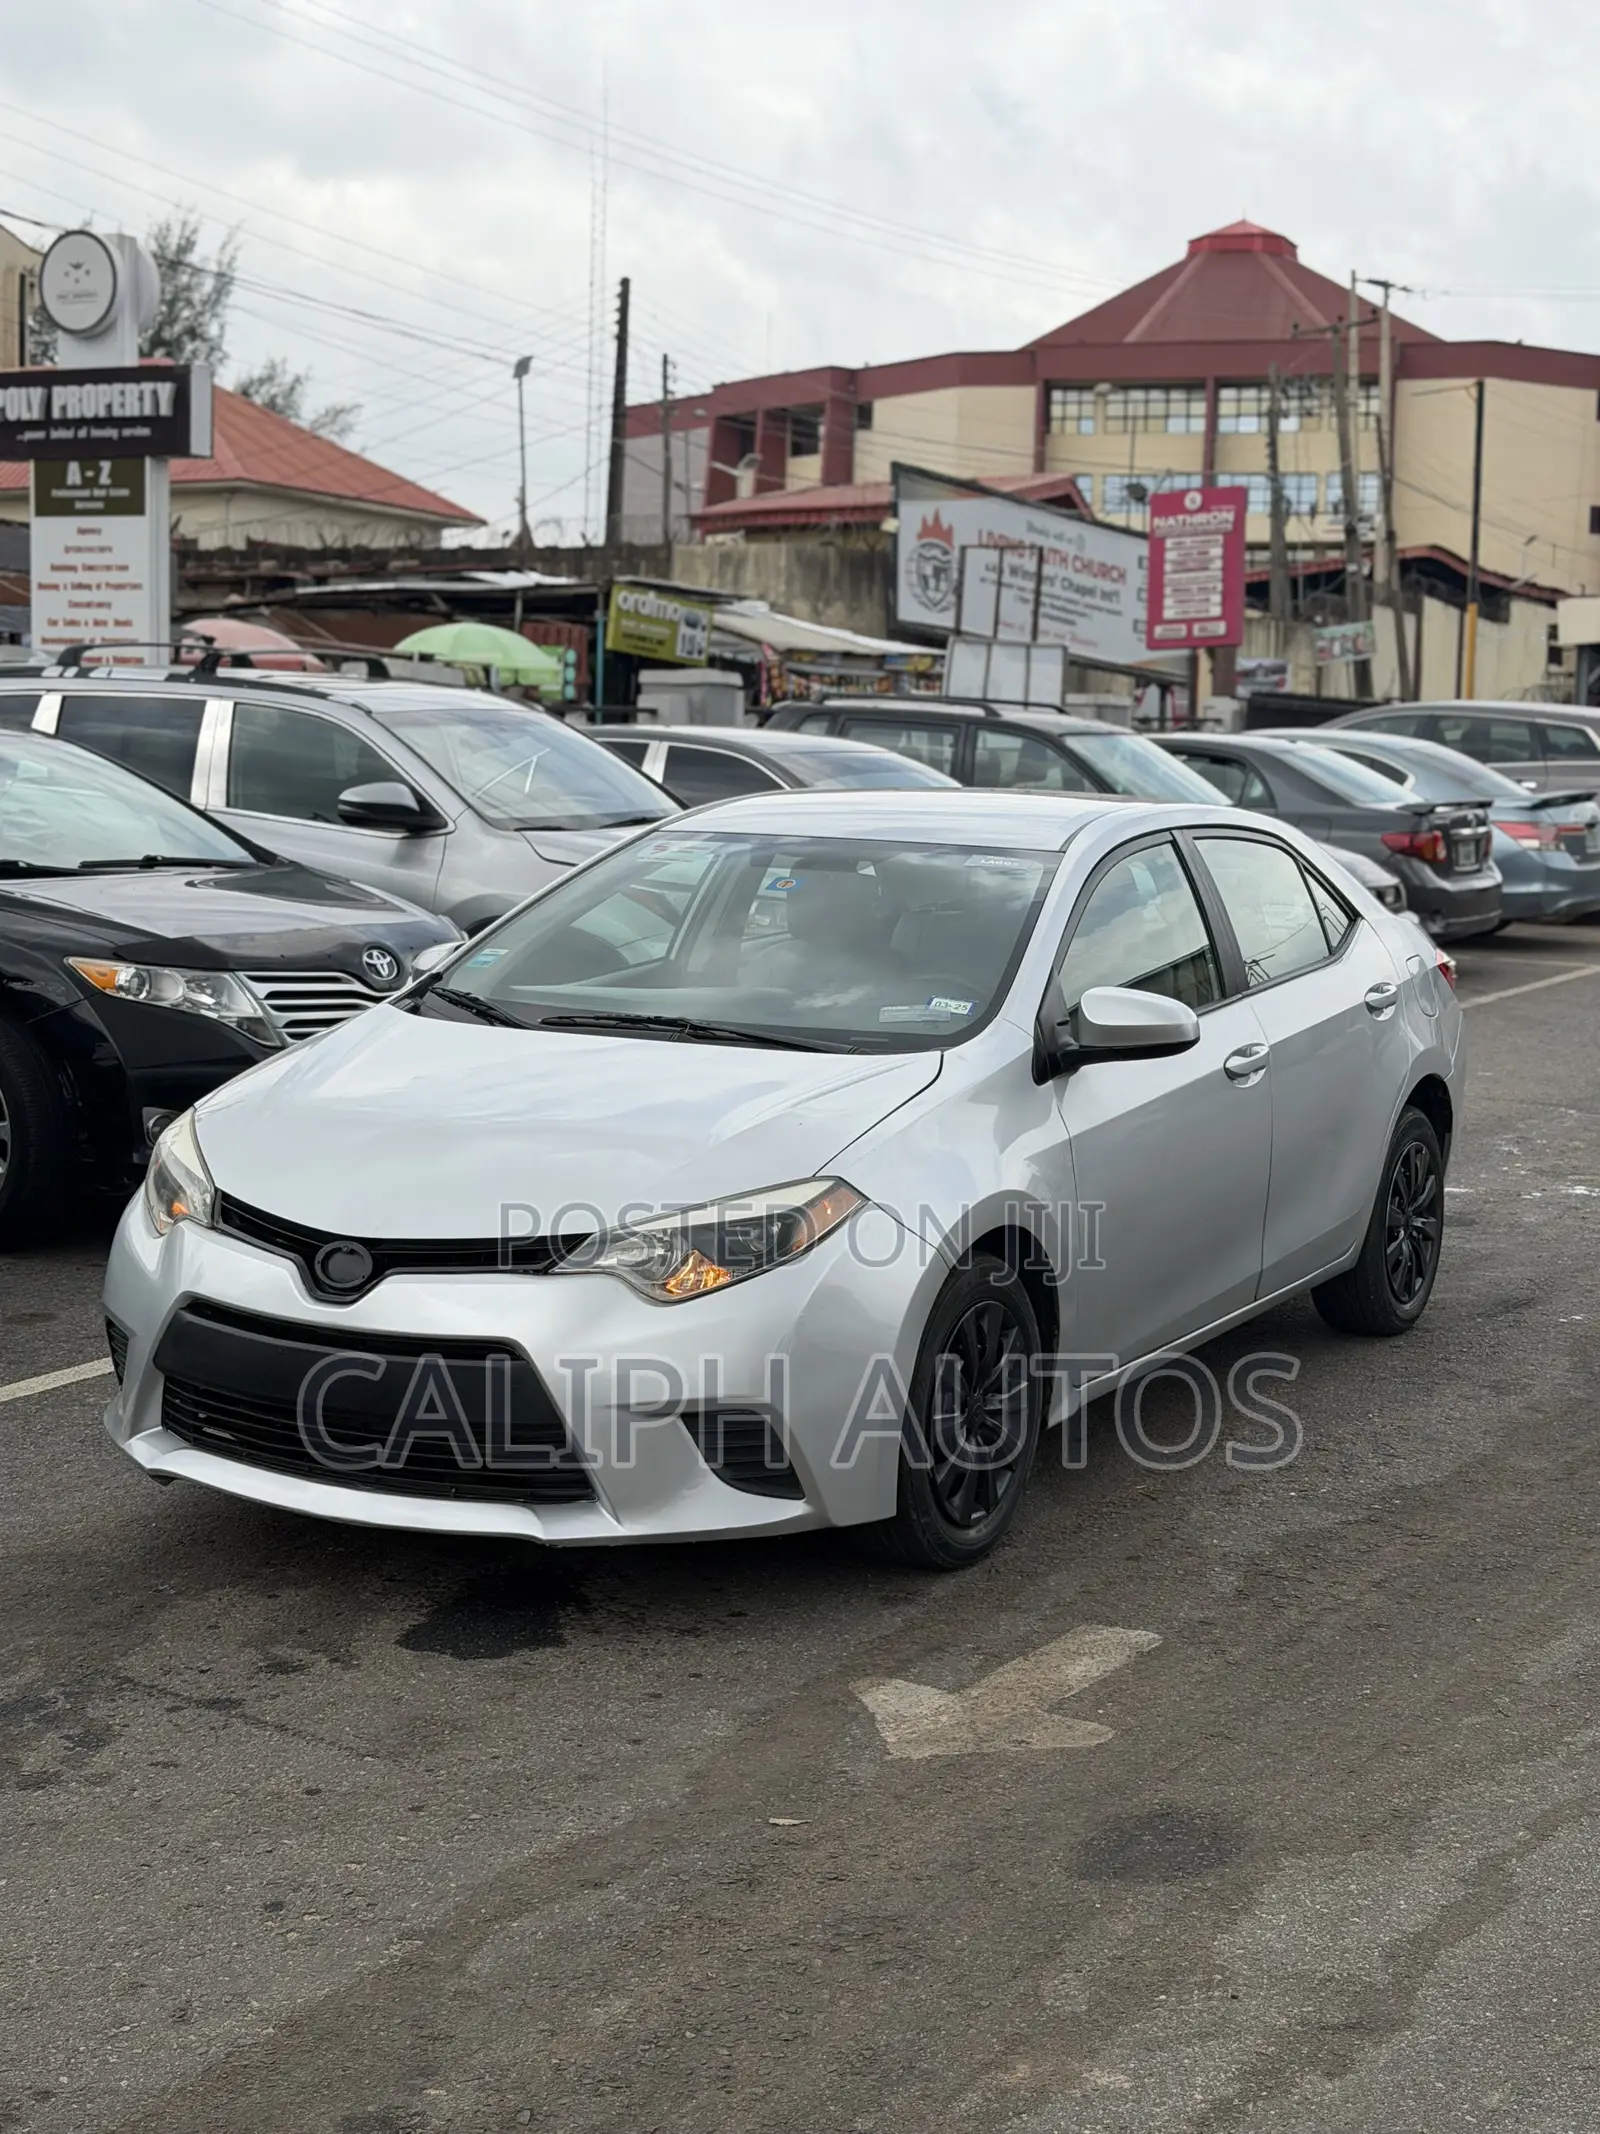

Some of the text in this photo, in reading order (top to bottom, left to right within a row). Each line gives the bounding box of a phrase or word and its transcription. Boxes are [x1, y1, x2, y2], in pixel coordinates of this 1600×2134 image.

[51, 382, 177, 419] PROPERTY
[1153, 510, 1235, 529] NATHRON
[1029, 543, 1069, 570] FITH
[1072, 554, 1127, 585] CHURCH
[1061, 577, 1097, 600] Chapel
